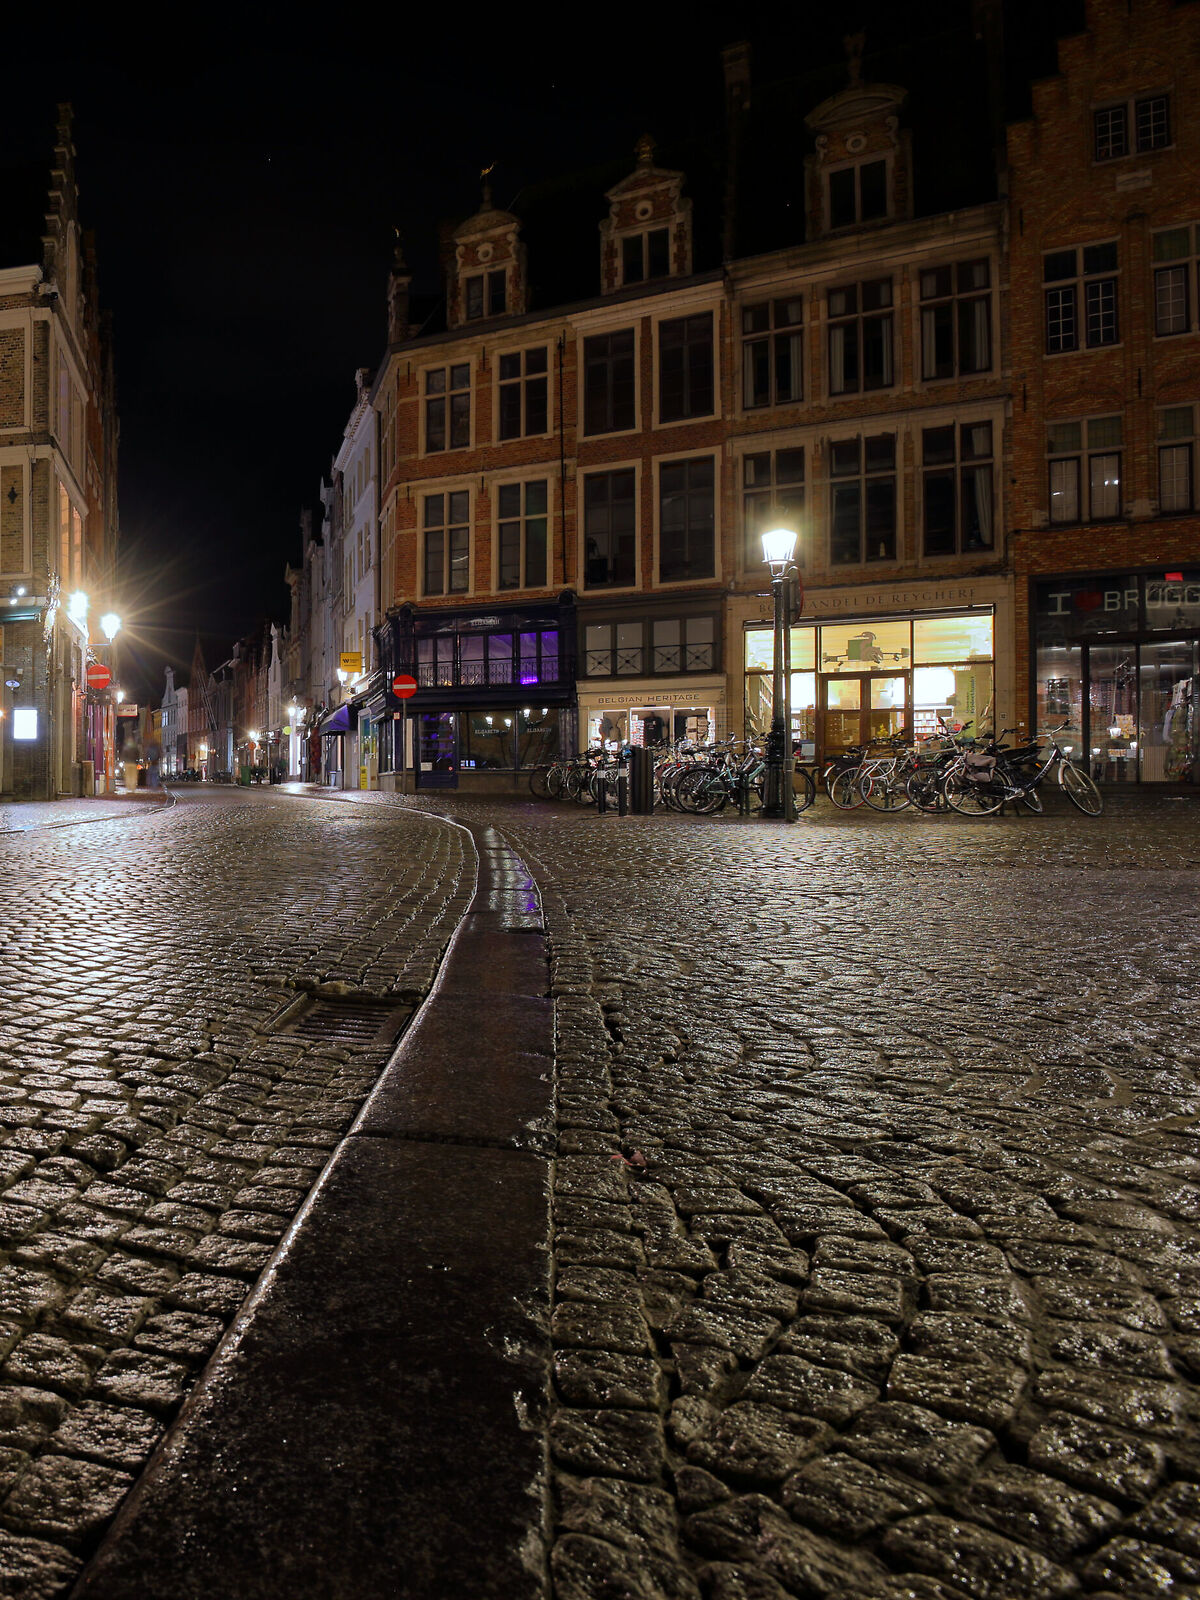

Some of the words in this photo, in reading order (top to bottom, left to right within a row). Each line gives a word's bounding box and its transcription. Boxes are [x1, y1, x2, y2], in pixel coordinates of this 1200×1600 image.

[866, 595, 885, 605] DE
[1048, 592, 1071, 615] I
[598, 696, 643, 704] BELGIAN
[647, 694, 700, 702] HERITAGE
